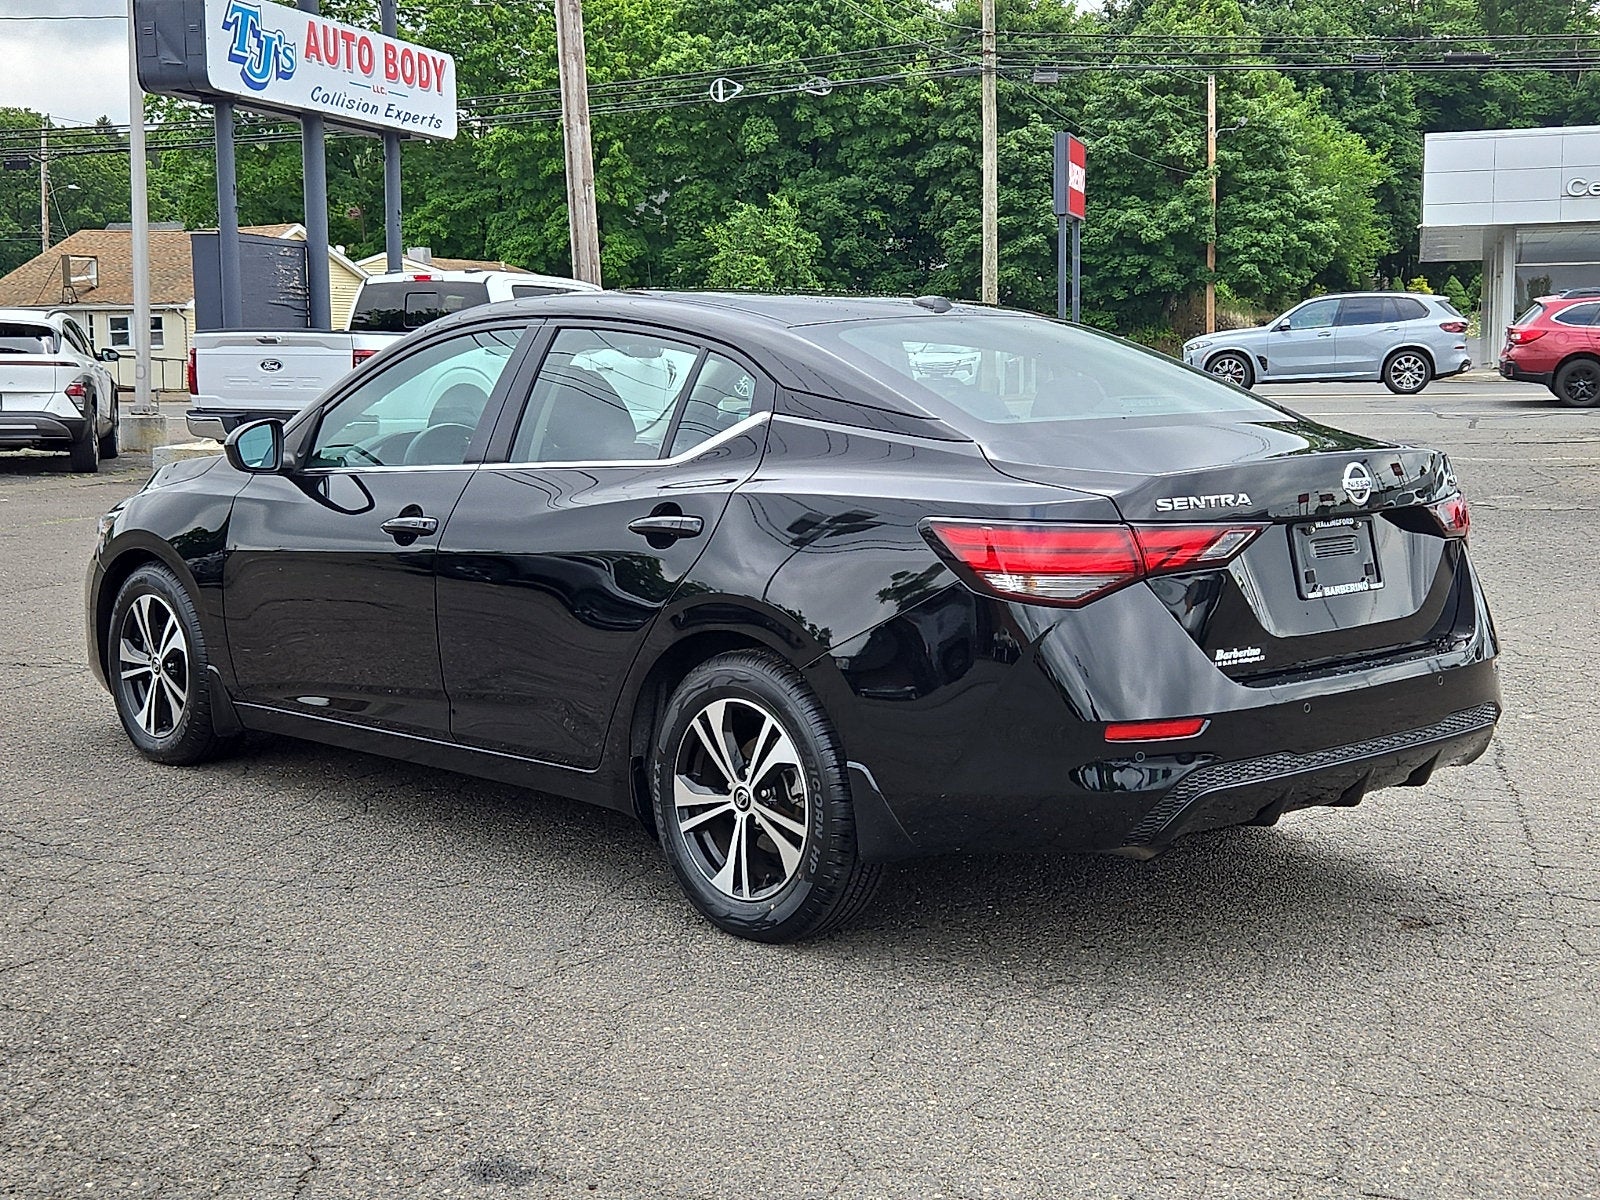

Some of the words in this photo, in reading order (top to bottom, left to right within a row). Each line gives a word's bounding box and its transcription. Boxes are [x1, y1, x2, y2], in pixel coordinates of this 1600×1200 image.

[222, 0, 297, 90] TJ's
[304, 20, 375, 76] AUTO
[384, 42, 446, 95] BODY
[310, 85, 380, 116] Collision
[384, 103, 443, 130] Experts
[1155, 493, 1253, 512] SENTRA
[1323, 581, 1369, 597] BARBERINO
[1214, 646, 1261, 661] Barberino
[809, 844, 821, 874] HP
